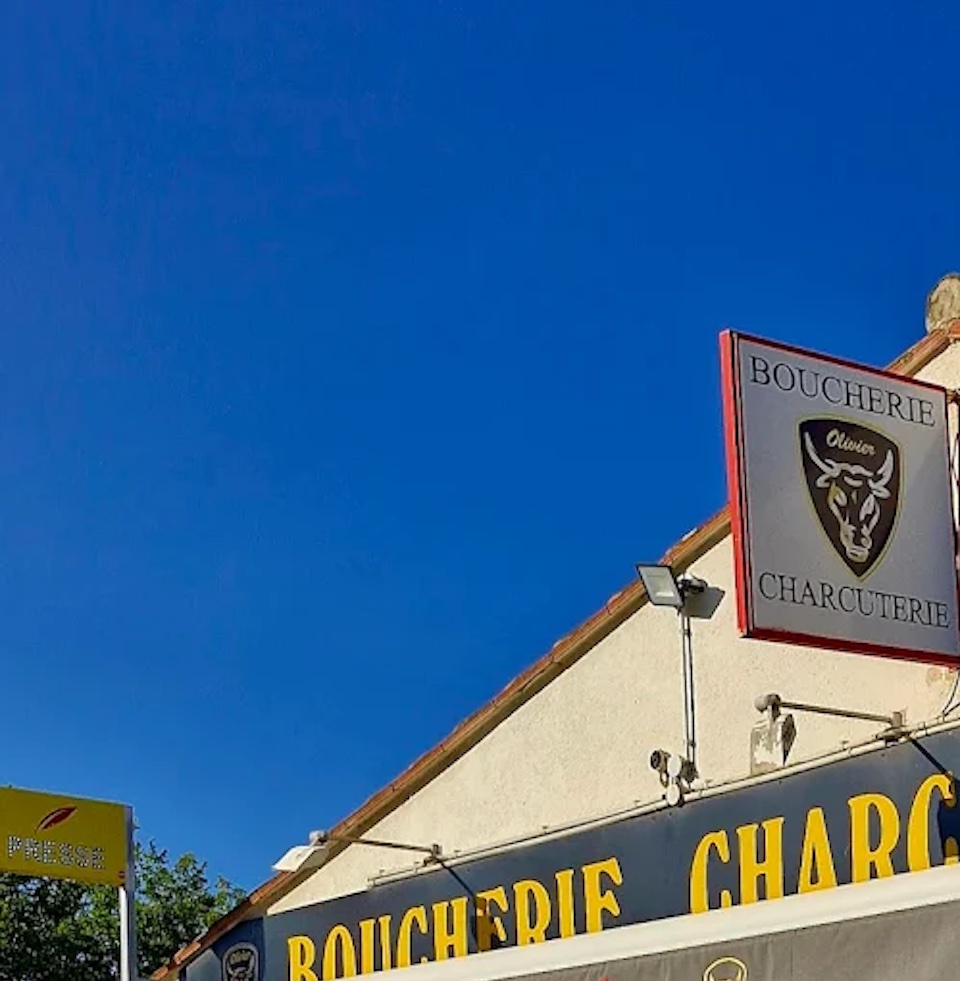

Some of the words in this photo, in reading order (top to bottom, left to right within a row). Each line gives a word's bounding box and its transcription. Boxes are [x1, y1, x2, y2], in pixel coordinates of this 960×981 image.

[749, 355, 936, 427] BOUCHERIE
[825, 427, 877, 457] Olivier
[758, 570, 950, 629] CHARCUTERIE
[7, 835, 106, 870] PRESSE
